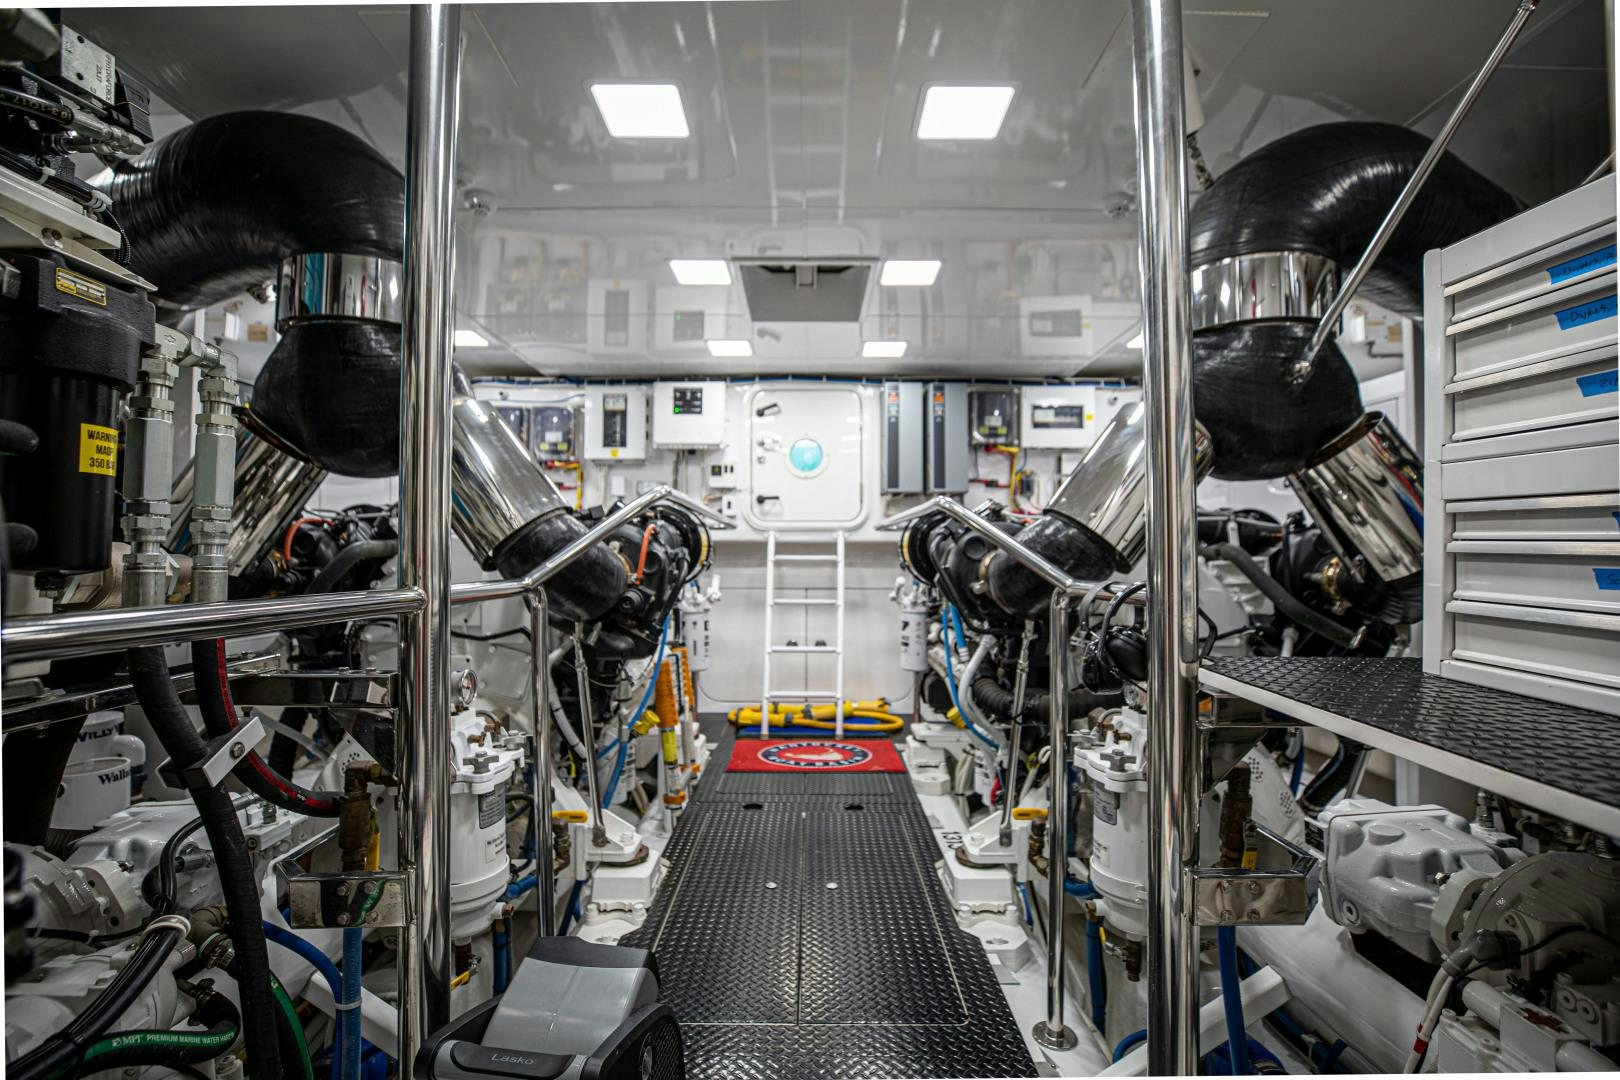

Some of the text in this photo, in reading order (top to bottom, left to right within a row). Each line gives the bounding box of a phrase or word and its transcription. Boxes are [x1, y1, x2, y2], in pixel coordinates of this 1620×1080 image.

[89, 457, 105, 468] 350
[146, 1034, 179, 1043] PREMIUM
[179, 1034, 202, 1044] MARINE
[202, 1035, 221, 1044] WATER
[491, 1053, 535, 1065] Lasko
